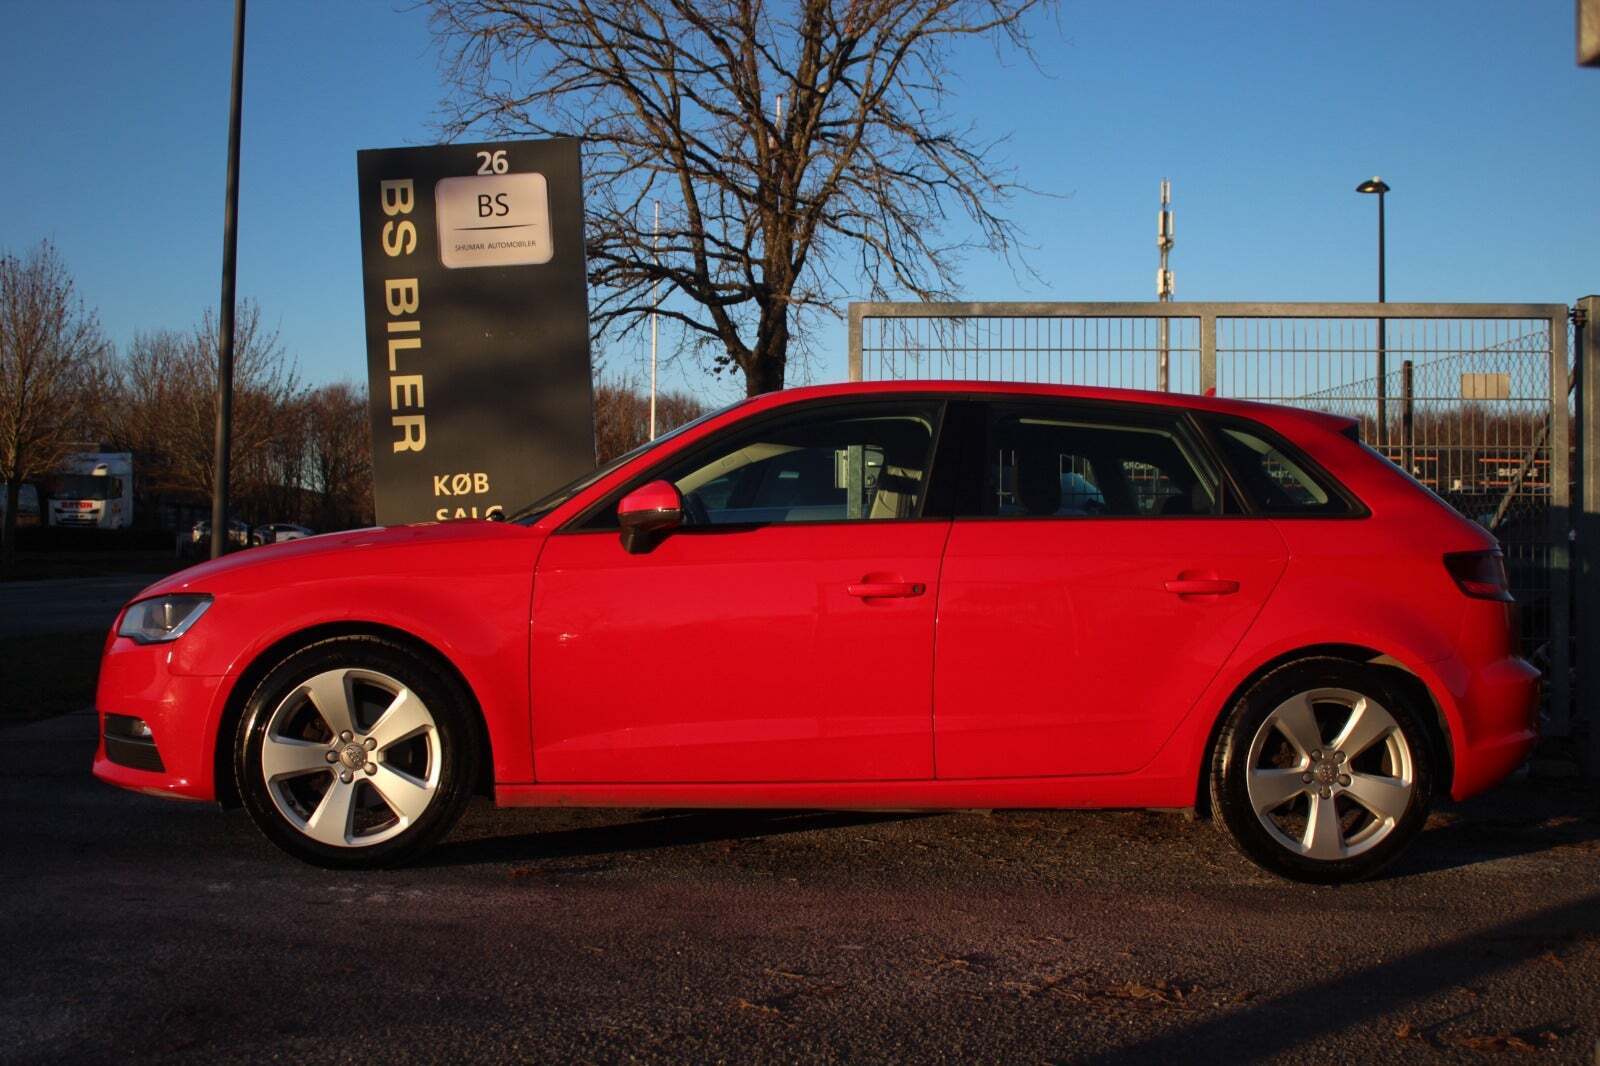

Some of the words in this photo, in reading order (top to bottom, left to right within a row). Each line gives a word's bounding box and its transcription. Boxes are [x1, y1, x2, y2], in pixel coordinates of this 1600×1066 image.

[476, 150, 509, 176] 26
[380, 178, 417, 257] BS
[477, 192, 510, 218] BS
[487, 240, 537, 250] AUTOMOBILER
[385, 278, 427, 454] BILER
[433, 472, 490, 496] KØB
